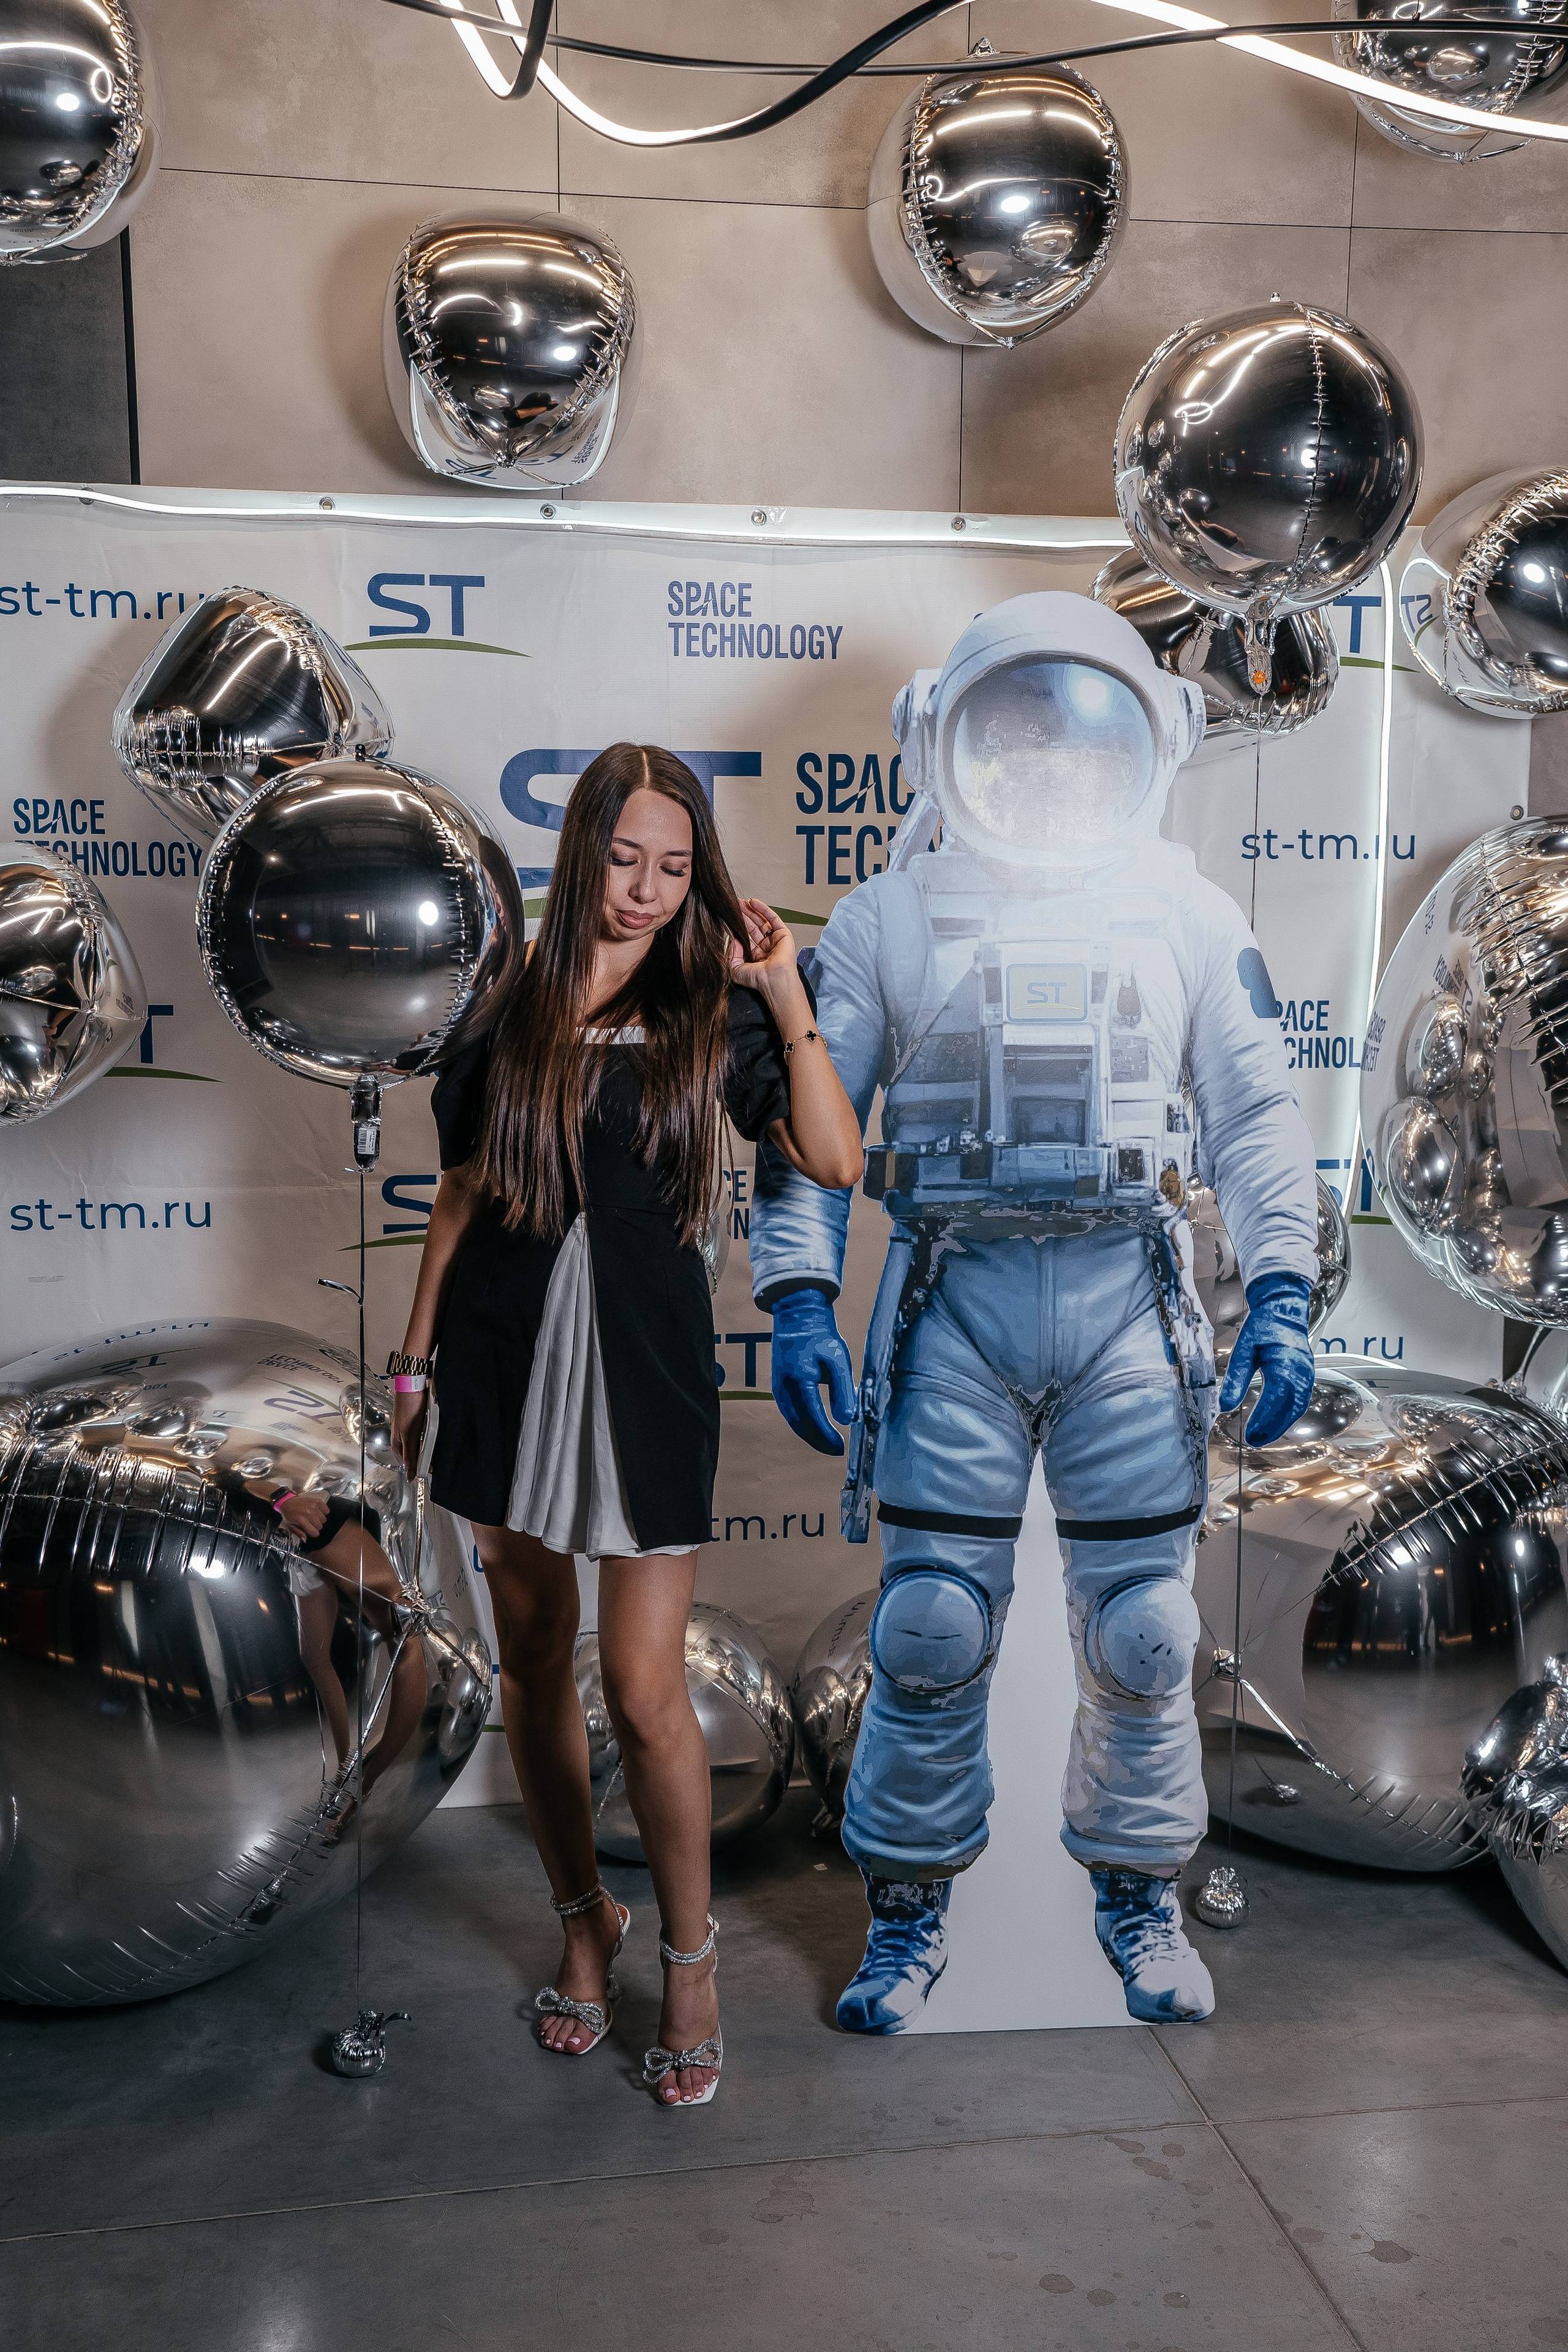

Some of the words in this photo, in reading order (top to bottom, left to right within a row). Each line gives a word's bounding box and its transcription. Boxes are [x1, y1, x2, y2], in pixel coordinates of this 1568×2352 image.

[367, 573, 485, 637] ST
[668, 581, 752, 617] SPACE
[668, 622, 843, 660] TECHNOLOGY
[1325, 595, 1382, 654] T
[13, 798, 105, 835] SPACE
[1027, 982, 1067, 1003] ST
[10, 1198, 211, 1231] st-tm.ru
[381, 1174, 444, 1235] S
